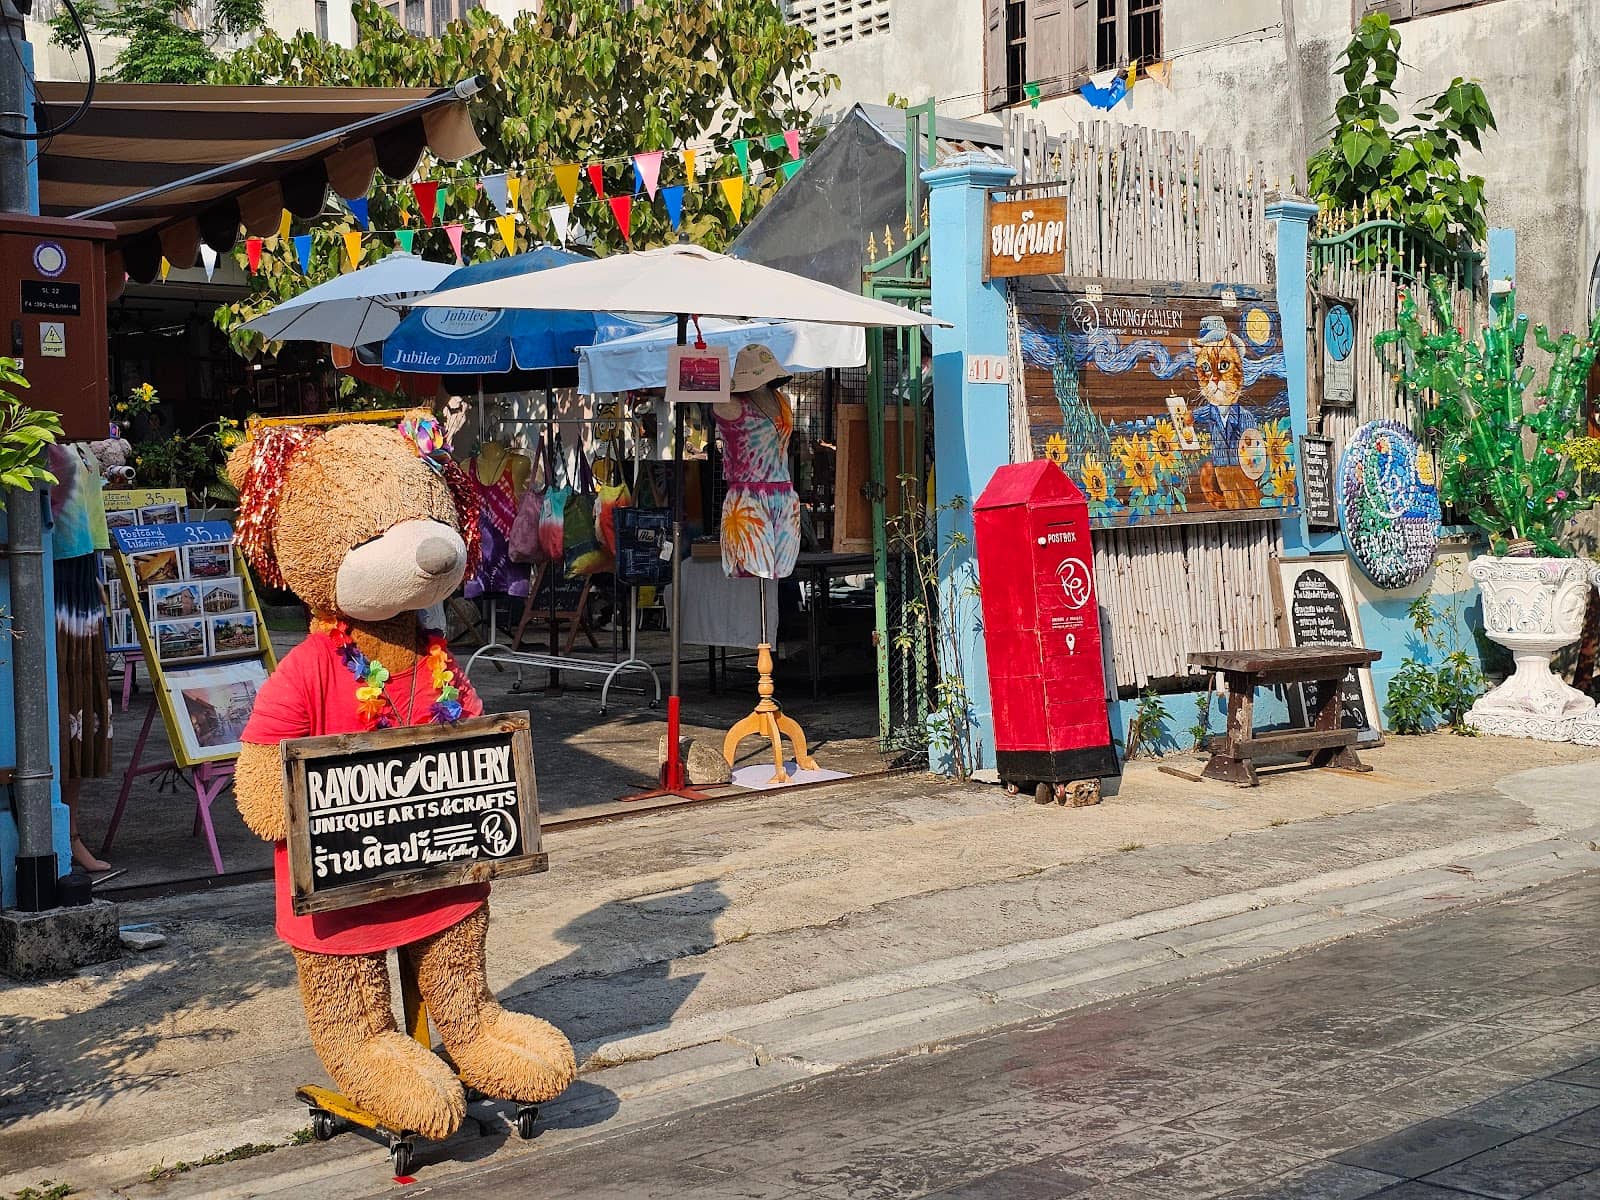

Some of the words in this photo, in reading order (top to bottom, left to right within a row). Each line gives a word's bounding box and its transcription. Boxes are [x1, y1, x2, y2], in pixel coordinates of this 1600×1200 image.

[440, 308, 488, 325] Jubilee
[1104, 307, 1140, 327] RAYONG
[1147, 308, 1184, 328] GALLERY
[42, 345, 64, 353] Danger
[392, 349, 441, 366] Jubilee
[446, 350, 498, 366] Diamond
[144, 492, 165, 506] 35
[118, 527, 165, 539] Postcard
[184, 526, 212, 544] 35
[1047, 532, 1077, 544] POSTBOX
[308, 759, 403, 810] RAYONG
[419, 745, 511, 792] GALLERY
[310, 810, 386, 835] UNIQUE
[314, 829, 431, 878] ร้านศิลปะ
